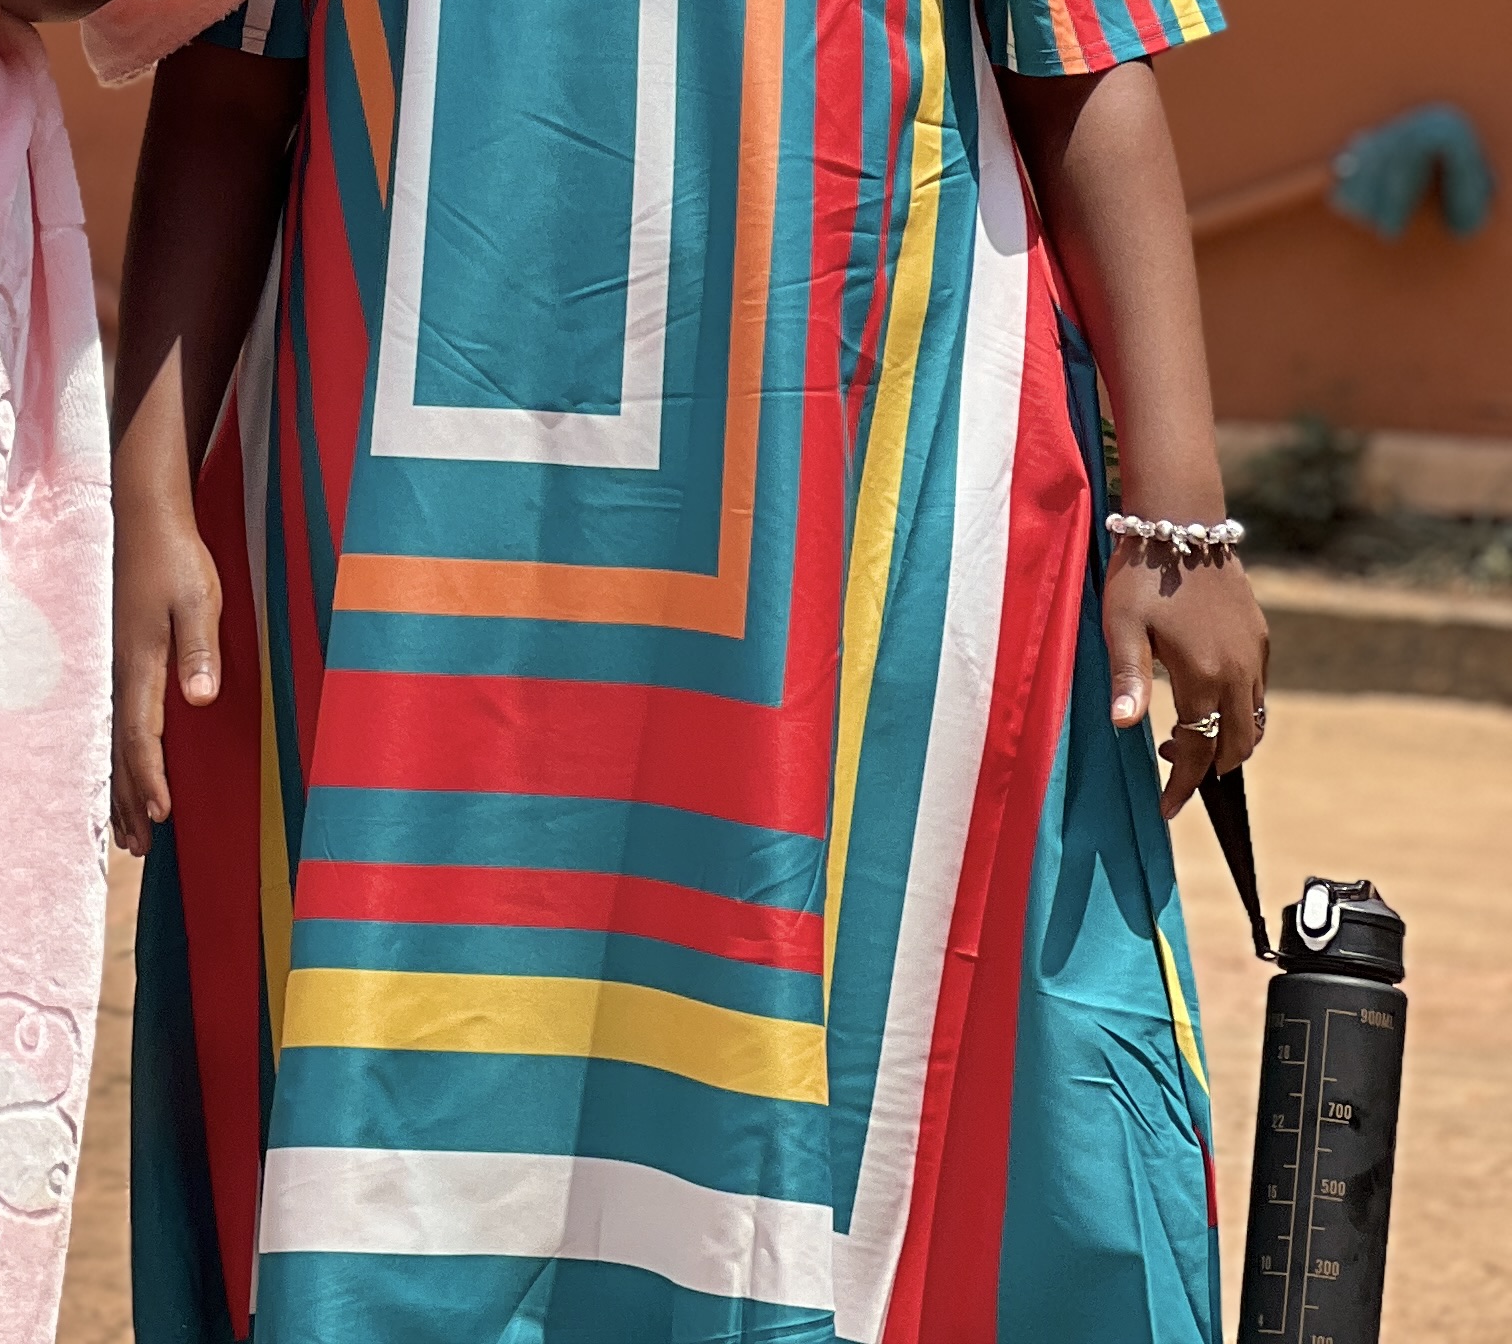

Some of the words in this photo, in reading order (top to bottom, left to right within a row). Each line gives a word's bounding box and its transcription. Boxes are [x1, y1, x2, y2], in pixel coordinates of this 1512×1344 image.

[1328, 1102, 1353, 1120] 700
[1267, 1184, 1278, 1199] 15
[1320, 1179, 1346, 1196] 500
[1314, 1259, 1340, 1277] 300
